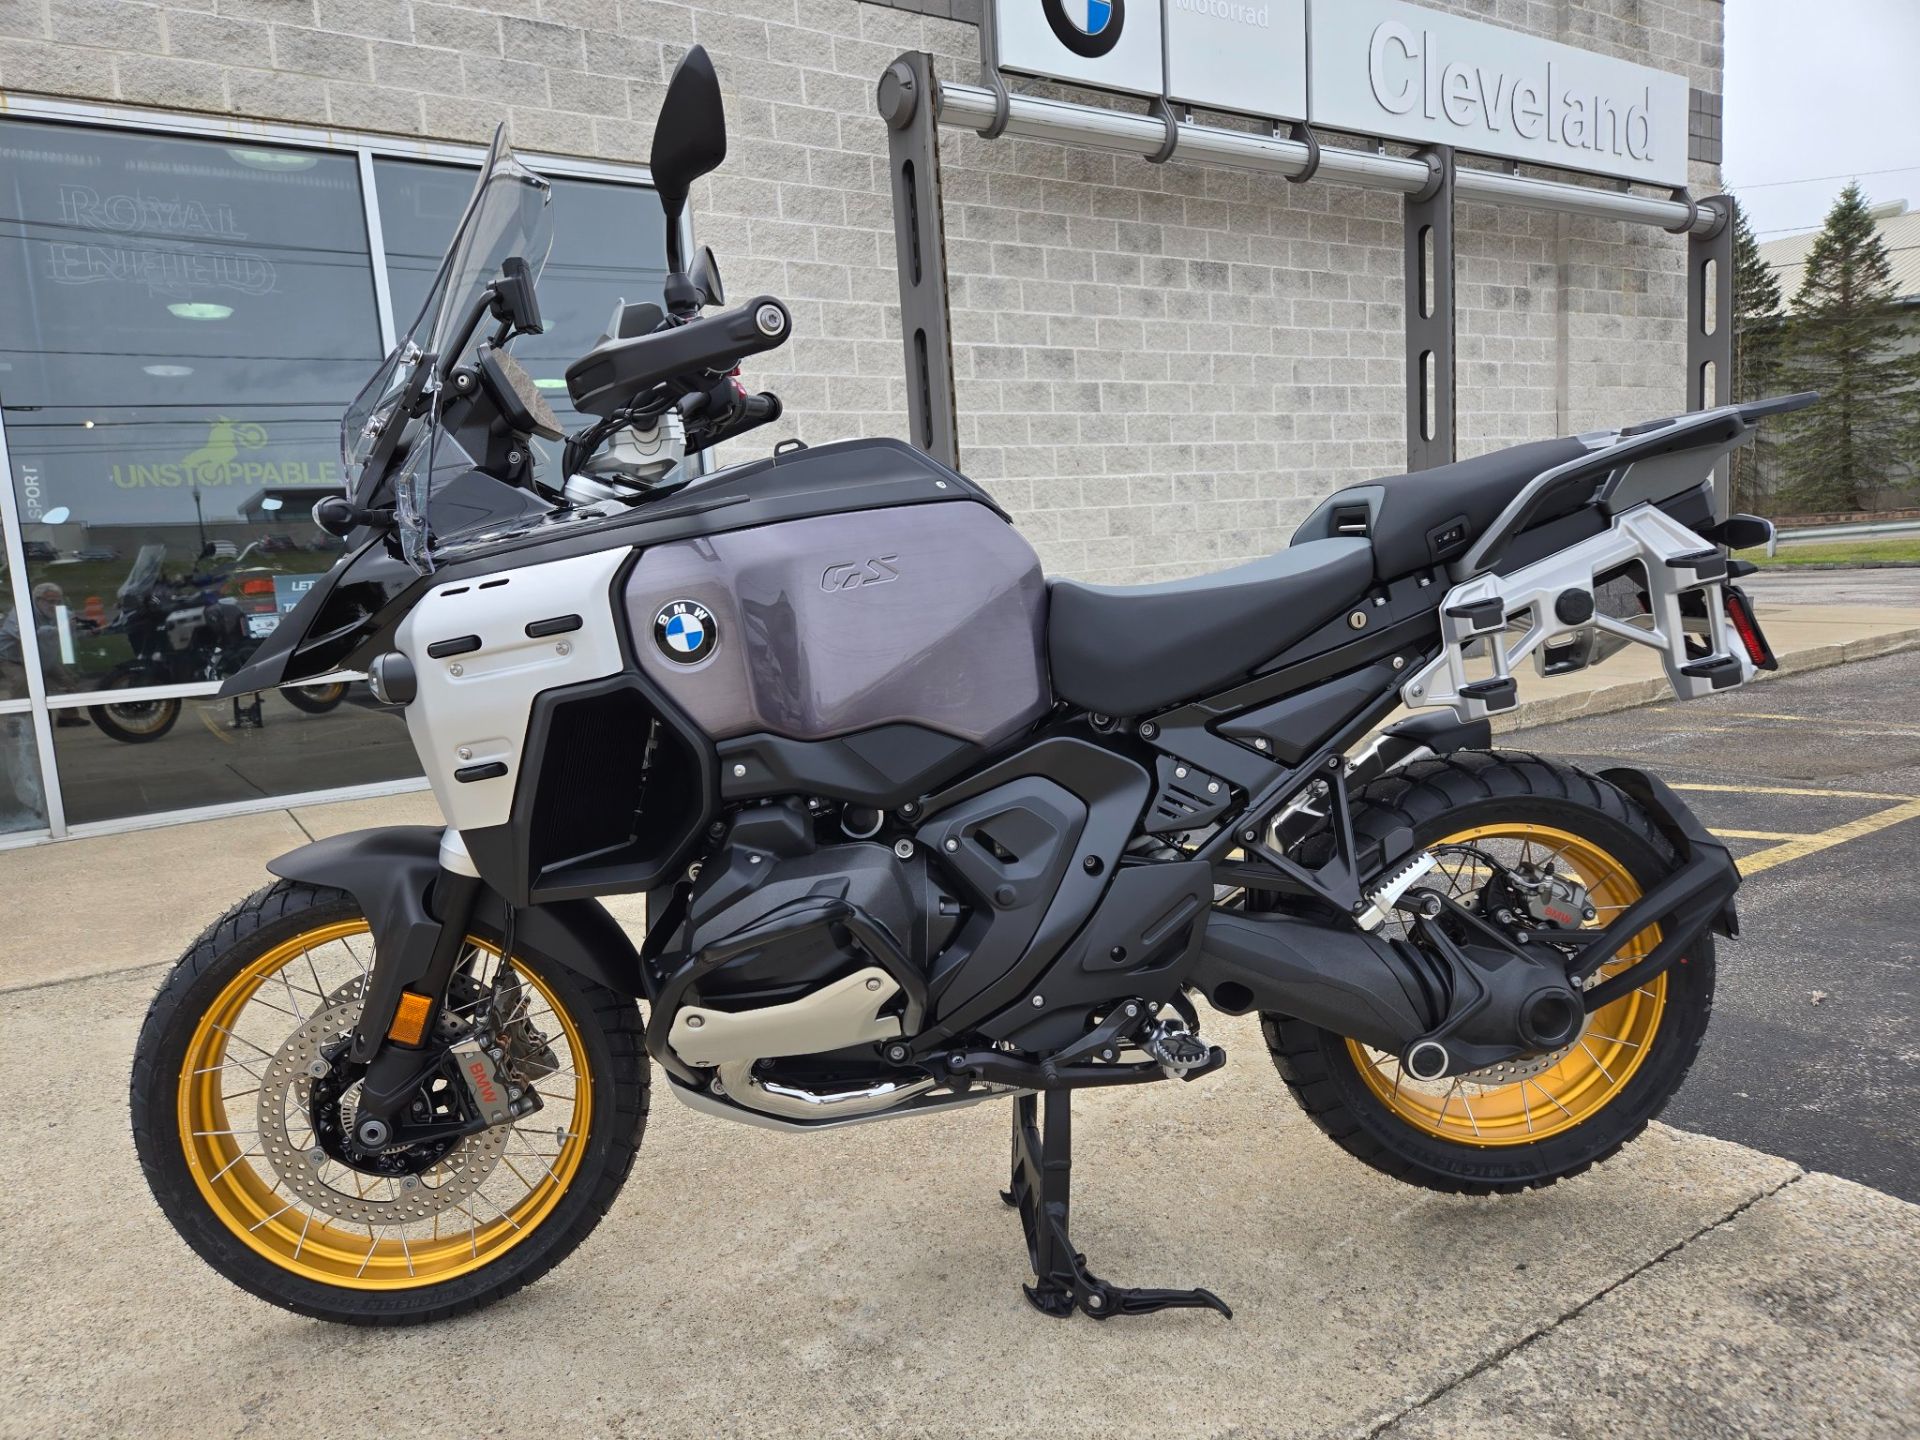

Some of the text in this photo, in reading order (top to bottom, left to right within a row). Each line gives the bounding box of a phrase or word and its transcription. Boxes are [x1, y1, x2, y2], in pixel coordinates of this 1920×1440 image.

[1368, 19, 1655, 162] Cleveland
[56, 183, 248, 241] ROYAL
[22, 465, 43, 520] SPORT
[112, 460, 341, 489] UNSTOPPABLE
[820, 554, 900, 593] GS
[657, 603, 708, 626] BMW
[1543, 906, 1573, 925] BMW
[469, 1061, 497, 1103] BMW
